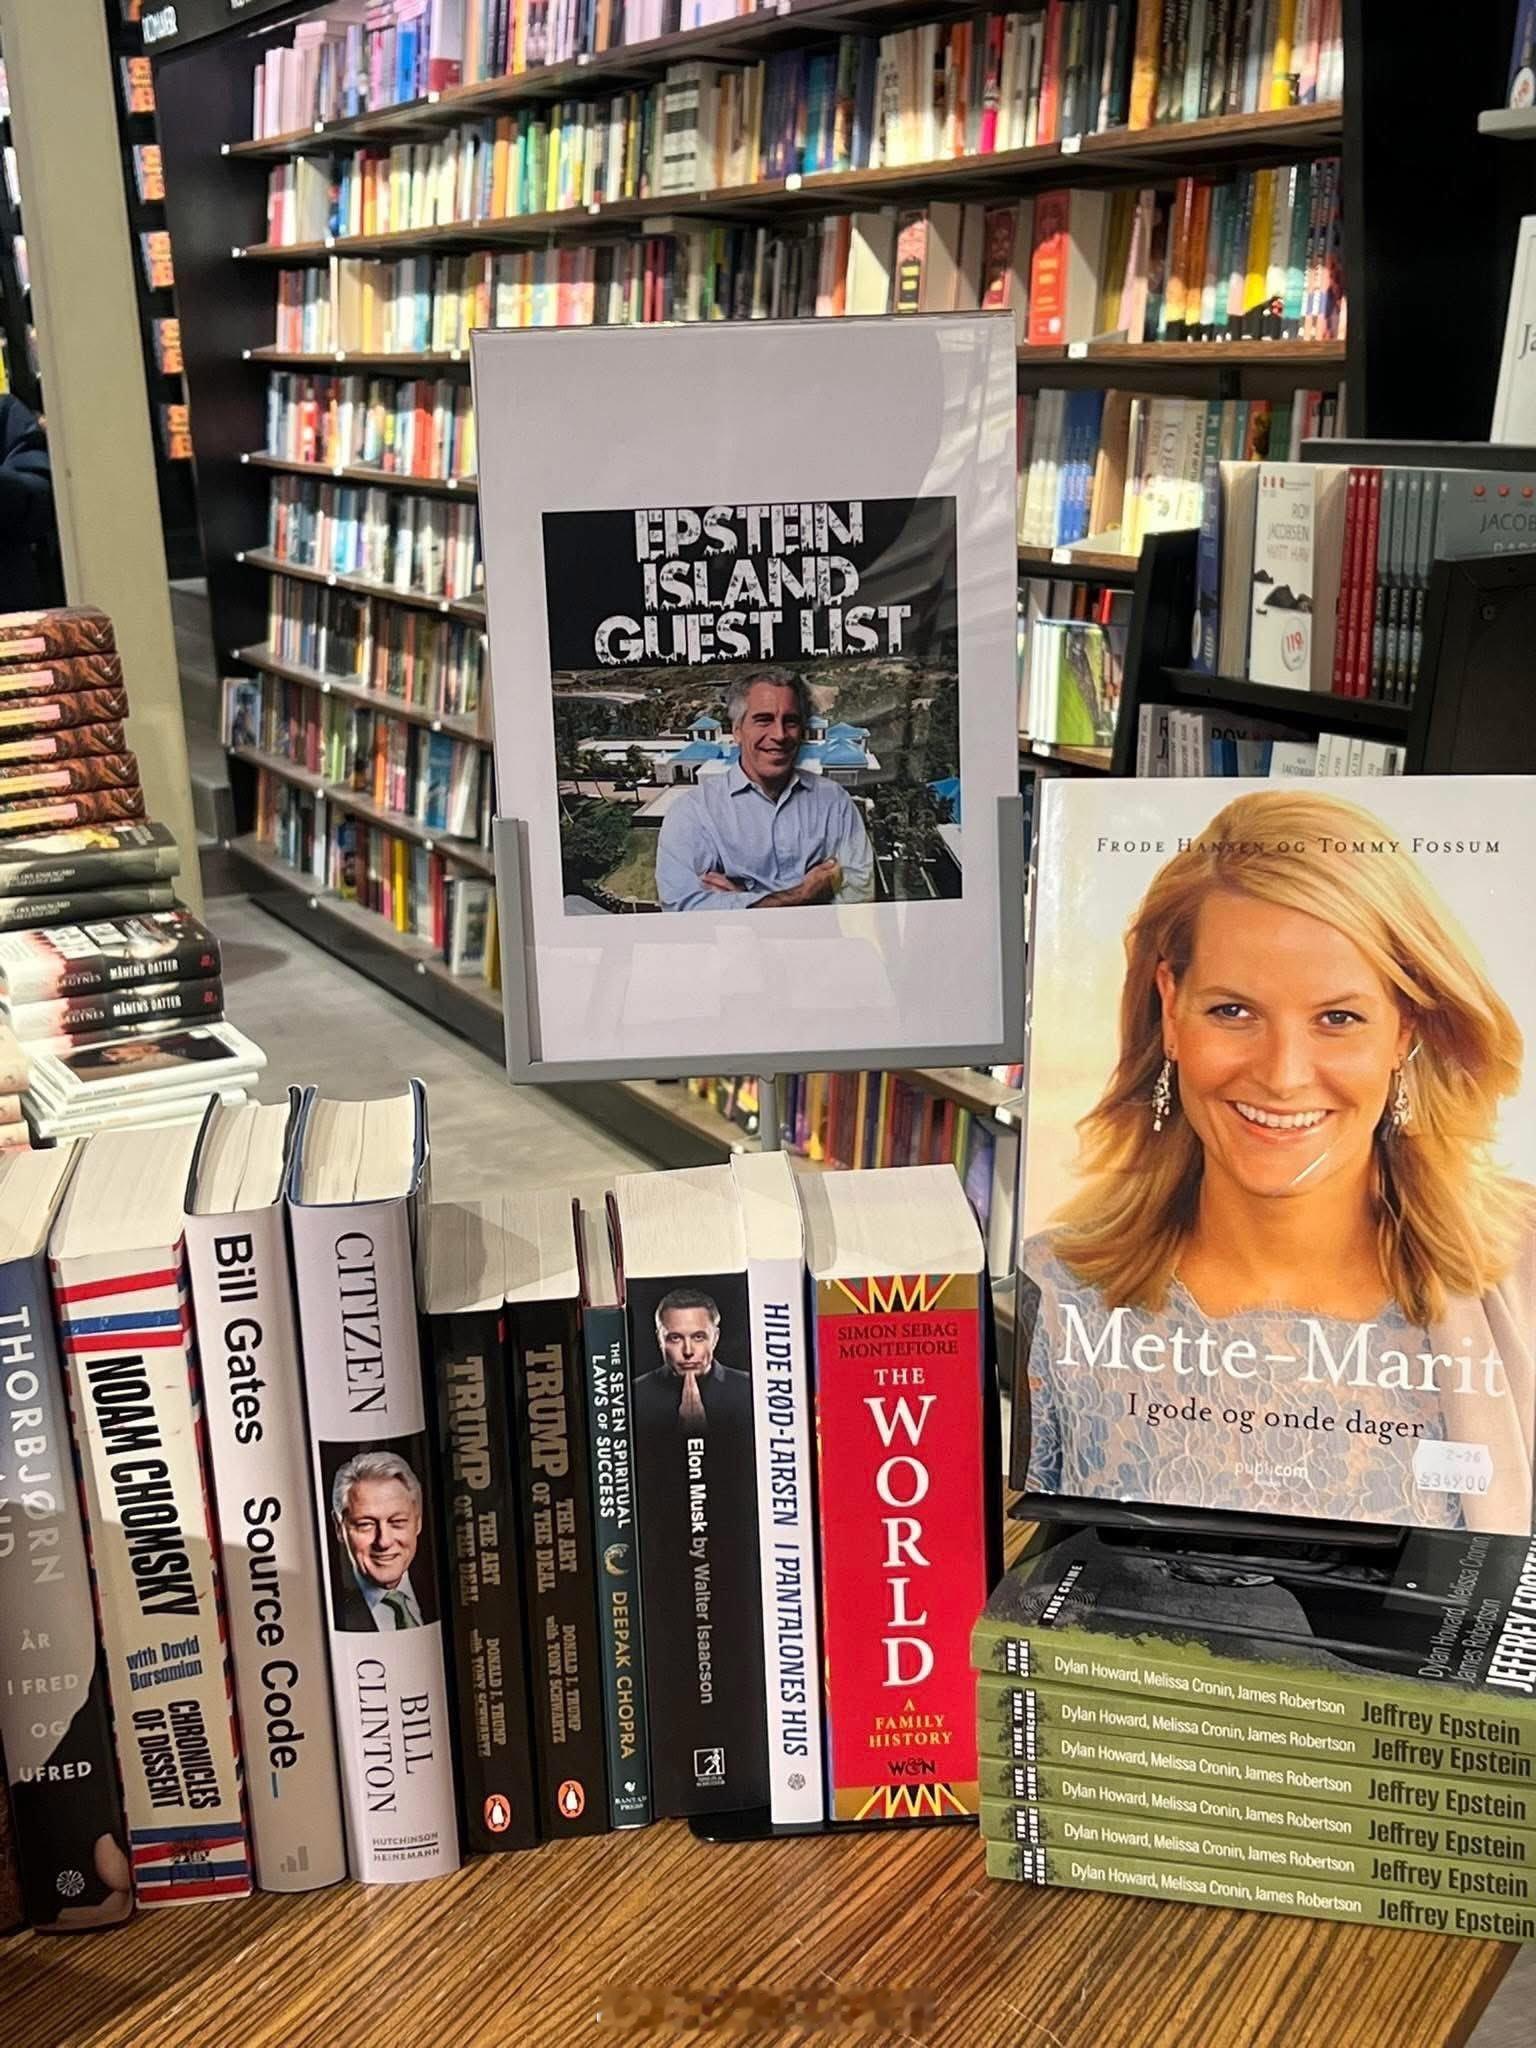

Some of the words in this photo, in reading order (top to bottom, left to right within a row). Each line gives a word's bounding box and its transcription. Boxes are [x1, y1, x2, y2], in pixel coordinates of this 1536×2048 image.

[635, 502, 863, 562] EPSTEIN
[644, 556, 859, 611] ISLAND
[594, 610, 782, 665] GUEST
[801, 605, 911, 657] LIST
[214, 1234, 258, 1303] Bill
[335, 1232, 388, 1414] CITIZEN
[763, 1303, 793, 1374] HILDE
[835, 1325, 897, 1342] SIMON
[902, 1322, 958, 1338] SEBAG
[610, 1341, 621, 1365] THE
[838, 1340, 958, 1359] MONTEFIORE
[1056, 1303, 1507, 1398] Mette-Marit
[224, 1318, 267, 1445] Gates
[592, 1354, 609, 1406] LAWS
[873, 1368, 926, 1386] THE
[85, 1355, 163, 1456] NOAM
[446, 1355, 491, 1490] TRUMP
[525, 1344, 569, 1478] TRUMP
[597, 1413, 608, 1430] OF
[610, 1372, 627, 1433] SEVEN
[1127, 1393, 1138, 1417] I
[1147, 1397, 1213, 1426] gode
[1223, 1407, 1256, 1434] og
[1265, 1405, 1335, 1433] onde
[1346, 1412, 1425, 1445] dager
[687, 1438, 704, 1479] Elon
[767, 1377, 799, 1526] RØD-LARSEN
[531, 1481, 550, 1505] OF
[596, 1436, 615, 1519] SUCCESS
[613, 1439, 631, 1529] SPIRITUAL
[478, 1512, 499, 1547] THE
[533, 1510, 553, 1545] THE
[556, 1498, 575, 1535] THE
[689, 1484, 708, 1534] Musk
[110, 1459, 200, 1616] CHOMSKY
[558, 1539, 578, 1573] ART
[689, 1536, 706, 1560] by
[863, 1394, 937, 1687] WORLD
[243, 1497, 284, 1647] Source
[481, 1552, 501, 1586] ART
[536, 1548, 556, 1594] DEAL
[693, 1563, 712, 1621] Walter
[1042, 1590, 1066, 1621] TRUE
[1058, 1564, 1084, 1593] CRIME
[20, 1629, 50, 1651] ÅR
[612, 1591, 631, 1669] DEEPAK
[776, 1557, 806, 1704] PANTALONES
[1430, 1605, 1470, 1647] Howard,
[1462, 1599, 1501, 1648] Robertson
[126, 1646, 157, 1671] with
[161, 1635, 200, 1664] David
[562, 1624, 578, 1675] DONALD
[696, 1624, 713, 1705] Isaacson
[1008, 1642, 1017, 1671] TRUE
[1020, 1640, 1029, 1677] CRIME
[1418, 1646, 1452, 1678] Dylan
[1450, 1650, 1485, 1684] James
[21, 1673, 79, 1696] FRED
[130, 1659, 203, 1691] Barsamian
[1054, 1656, 1089, 1676] Dylan
[1091, 1662, 1142, 1685] Howard,
[1144, 1671, 1189, 1691] Melissa
[1192, 1678, 1235, 1700] Cronin,
[1237, 1688, 1276, 1704] James
[1280, 1691, 1345, 1715] Robertson
[132, 1708, 166, 1731] OF
[567, 1689, 582, 1732] TRUMP
[616, 1676, 636, 1759] CHOPRA
[875, 1714, 945, 1730] FAMILY
[903, 1698, 916, 1712] A
[1014, 1692, 1023, 1721] TRUE
[1026, 1690, 1035, 1724] CRIME
[1361, 1701, 1433, 1737] Jeffrey
[1439, 1713, 1520, 1745] Epstein
[31, 1721, 67, 1739] OG
[356, 1658, 397, 1814] CLINTON
[400, 1692, 434, 1775] BILL
[782, 1710, 808, 1757] HUS
[868, 1731, 953, 1748] HISTORY
[1061, 1705, 1096, 1725] Dylan
[1099, 1710, 1150, 1732] Howard,
[1152, 1717, 1199, 1736] Melissa
[1201, 1724, 1246, 1744] Cronin,
[1242, 1728, 1286, 1745] James
[1290, 1731, 1355, 1753] Robertson
[20, 1760, 92, 1783] UFRED
[138, 1734, 185, 1809] DISSENT
[167, 1699, 222, 1811] CHRONICLES
[1372, 1738, 1444, 1770] Jeffrey
[1450, 1748, 1531, 1778] Epstein
[1015, 1767, 1024, 1796] TRUE
[1028, 1766, 1037, 1800] CRIME
[1062, 1781, 1096, 1802] Dylan
[1100, 1788, 1148, 1809] Howard,
[1152, 1794, 1197, 1812] Melissa
[1199, 1801, 1242, 1821] Cronin,
[1245, 1808, 1284, 1825] James
[1286, 1811, 1352, 1833] Robertson
[372, 1831, 439, 1847] HUTCHINSON
[373, 1848, 440, 1862] HEINEMANN
[1368, 1820, 1439, 1851] Jeffrey
[1445, 1830, 1526, 1861] Epstein
[1024, 1850, 1033, 1878] TRUE
[1037, 1847, 1045, 1884] CRIME
[1071, 1863, 1105, 1883] Dylan
[1108, 1869, 1158, 1889] Howard,
[1161, 1876, 1207, 1894] Melissa
[1209, 1883, 1252, 1901] Cronin,
[1254, 1887, 1294, 1905] James
[1296, 1891, 1361, 1913] Robertson
[1378, 1899, 1448, 1931] Jeffrey
[1455, 1909, 1534, 1938] Epstein
